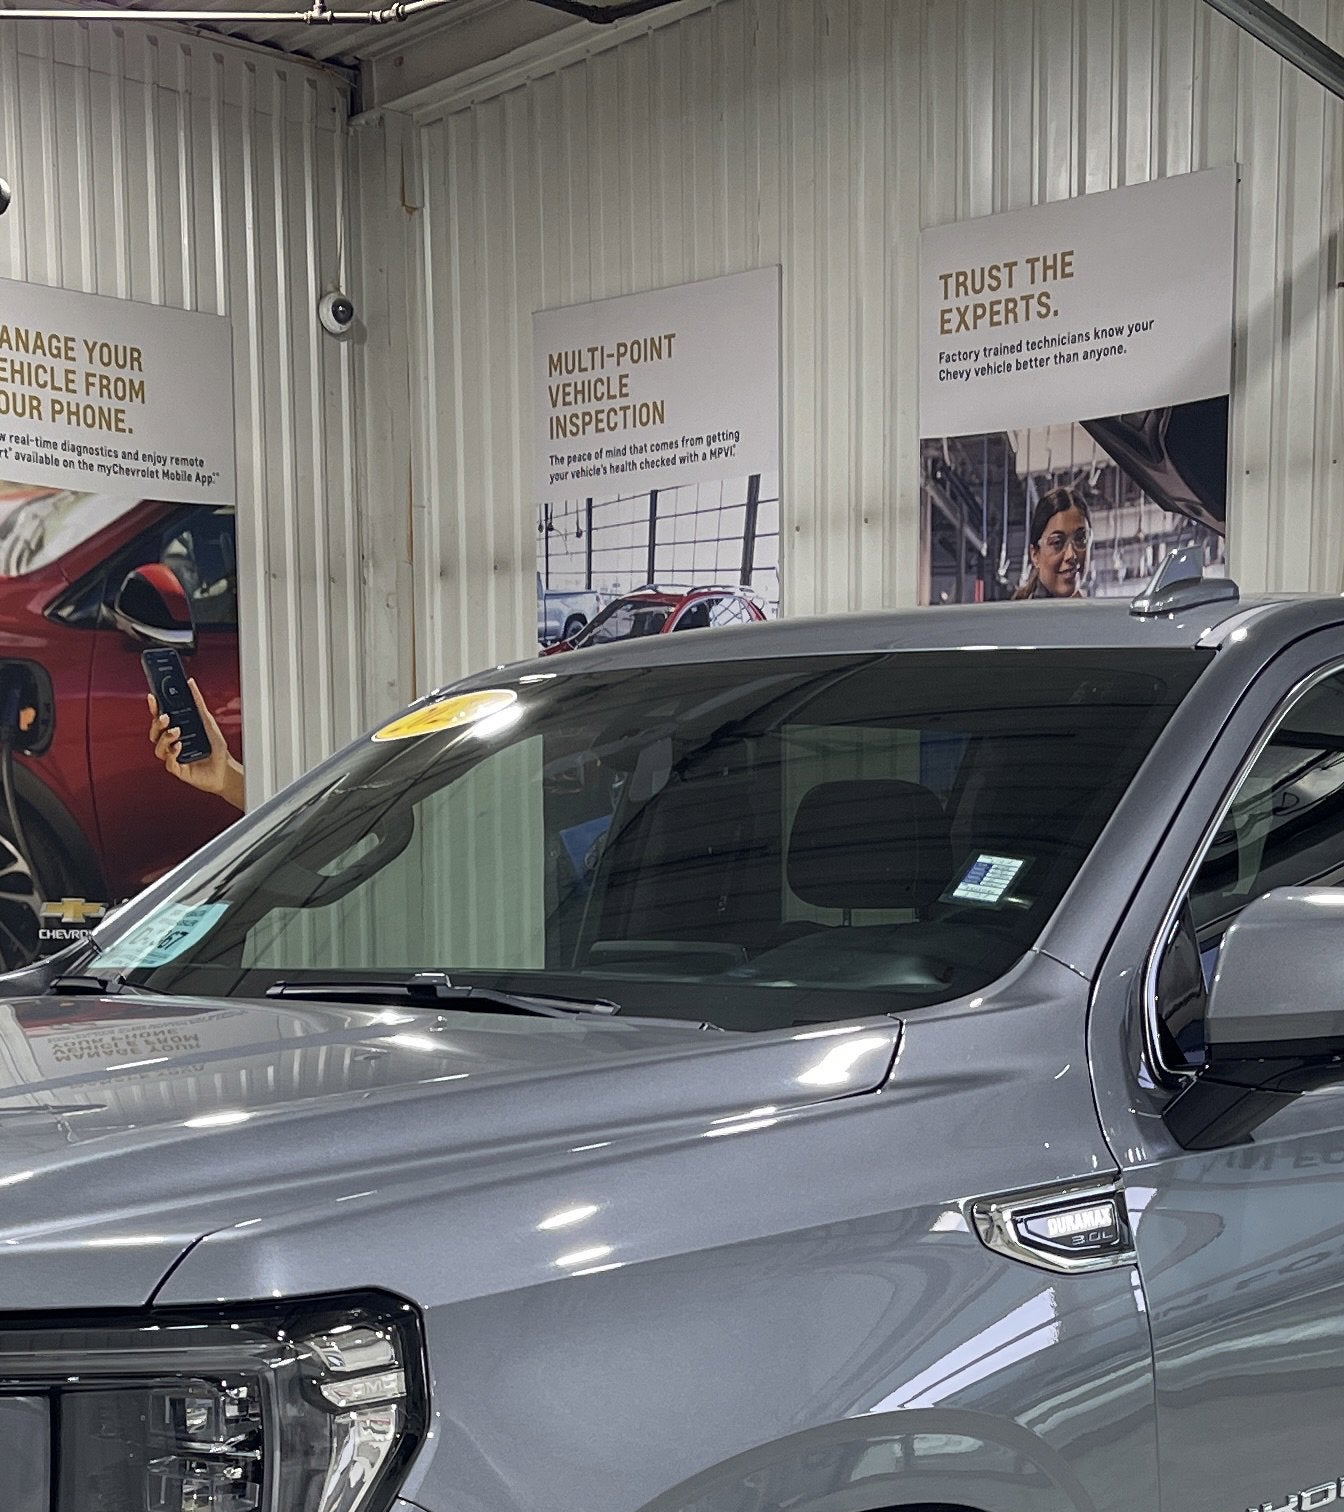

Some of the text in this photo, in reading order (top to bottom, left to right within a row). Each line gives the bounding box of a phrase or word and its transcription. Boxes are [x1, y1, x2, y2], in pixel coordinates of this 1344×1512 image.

[939, 250, 1075, 301] TRUST THE
[939, 291, 1060, 336] EXPERTS.
[84, 339, 143, 372] YOUR
[548, 333, 676, 378] MULTI-POINT
[939, 319, 1155, 366] Factory trained technicians know your
[938, 343, 1127, 383] Chevy vehicle better than anyone.
[85, 371, 145, 404] FROM
[548, 374, 629, 408] VEHICLE
[51, 398, 134, 434] PHONE.
[549, 400, 665, 440] INSPECTION
[9, 433, 58, 451] real-time
[61, 439, 118, 459] diagnostics
[121, 449, 139, 461] and
[141, 452, 168, 467] enjoy
[170, 455, 205, 468] remote
[549, 429, 740, 468] The peace of mind that comes from getting
[15, 451, 60, 467] available
[62, 459, 75, 469] on
[77, 459, 94, 472] the
[97, 463, 160, 480] myChevrolet
[162, 469, 192, 482] Mobile
[549, 470, 568, 485] your
[609, 459, 637, 475] health
[639, 453, 677, 471] checked
[679, 450, 699, 466] with
[701, 451, 707, 462] a
[1047, 1204, 1113, 1236] DURAMAX
[1071, 1233, 1113, 1246] 3.0L
